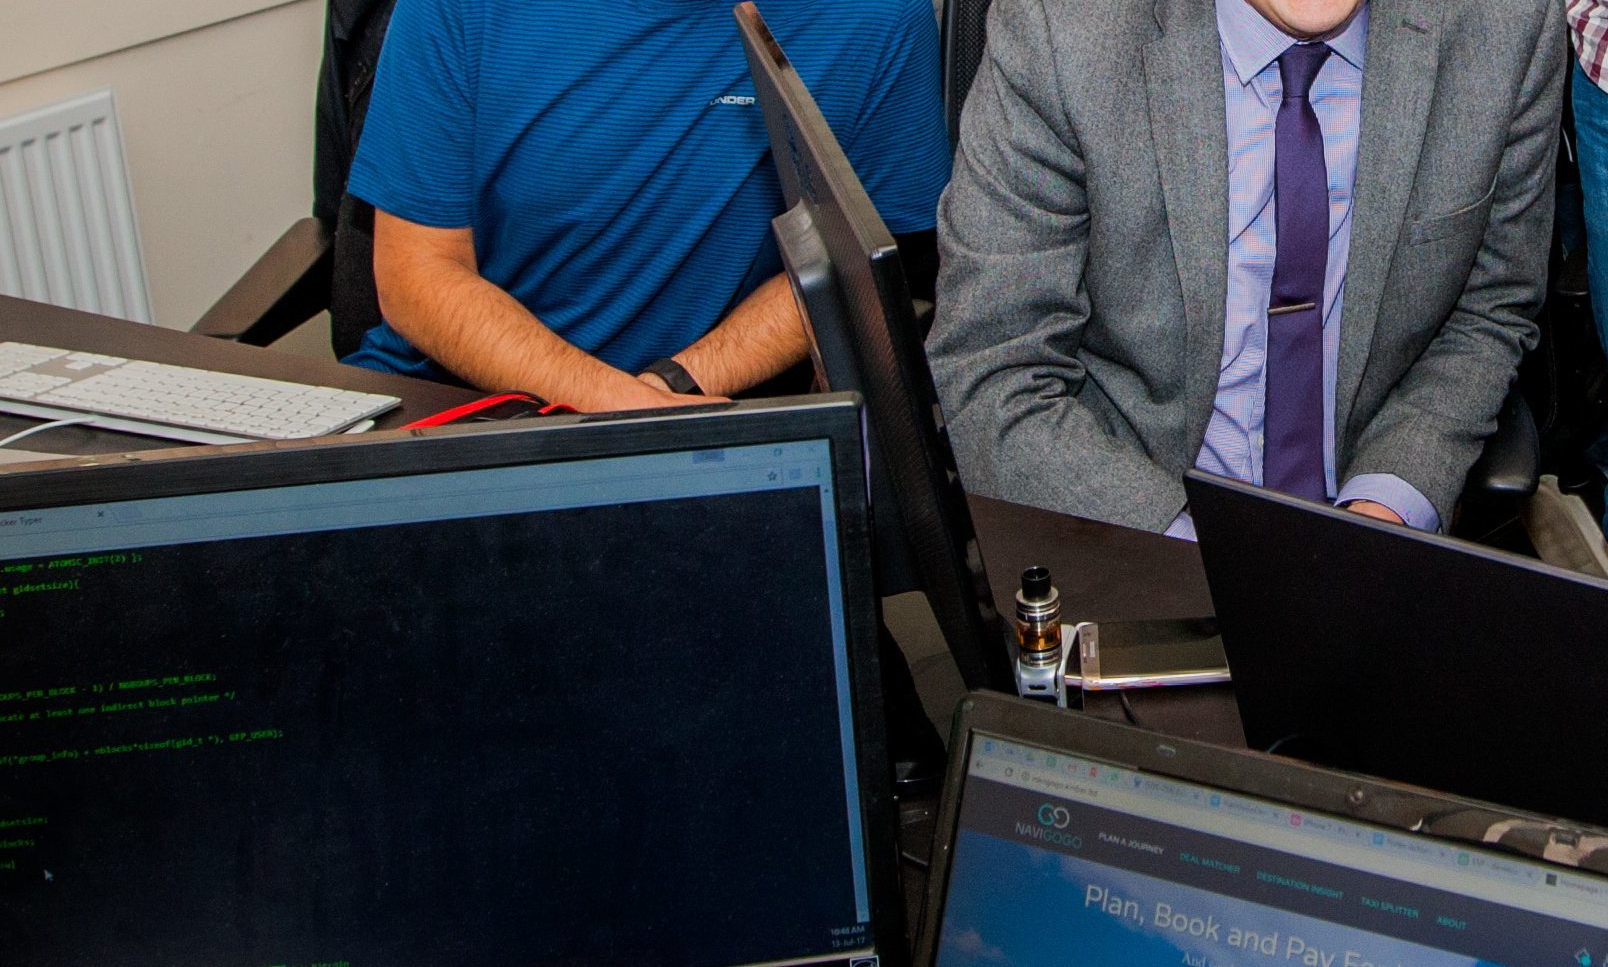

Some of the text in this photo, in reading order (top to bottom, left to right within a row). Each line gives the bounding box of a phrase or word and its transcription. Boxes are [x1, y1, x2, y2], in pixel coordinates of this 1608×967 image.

[1015, 821, 1083, 849] NAVIGOGO
[1098, 831, 1121, 845] PLAN
[1127, 838, 1165, 856] JOURNEY
[1083, 883, 1144, 926] Plan,
[1153, 901, 1221, 942] Book
[1227, 926, 1279, 957] and
[1285, 936, 1336, 967] Pay
